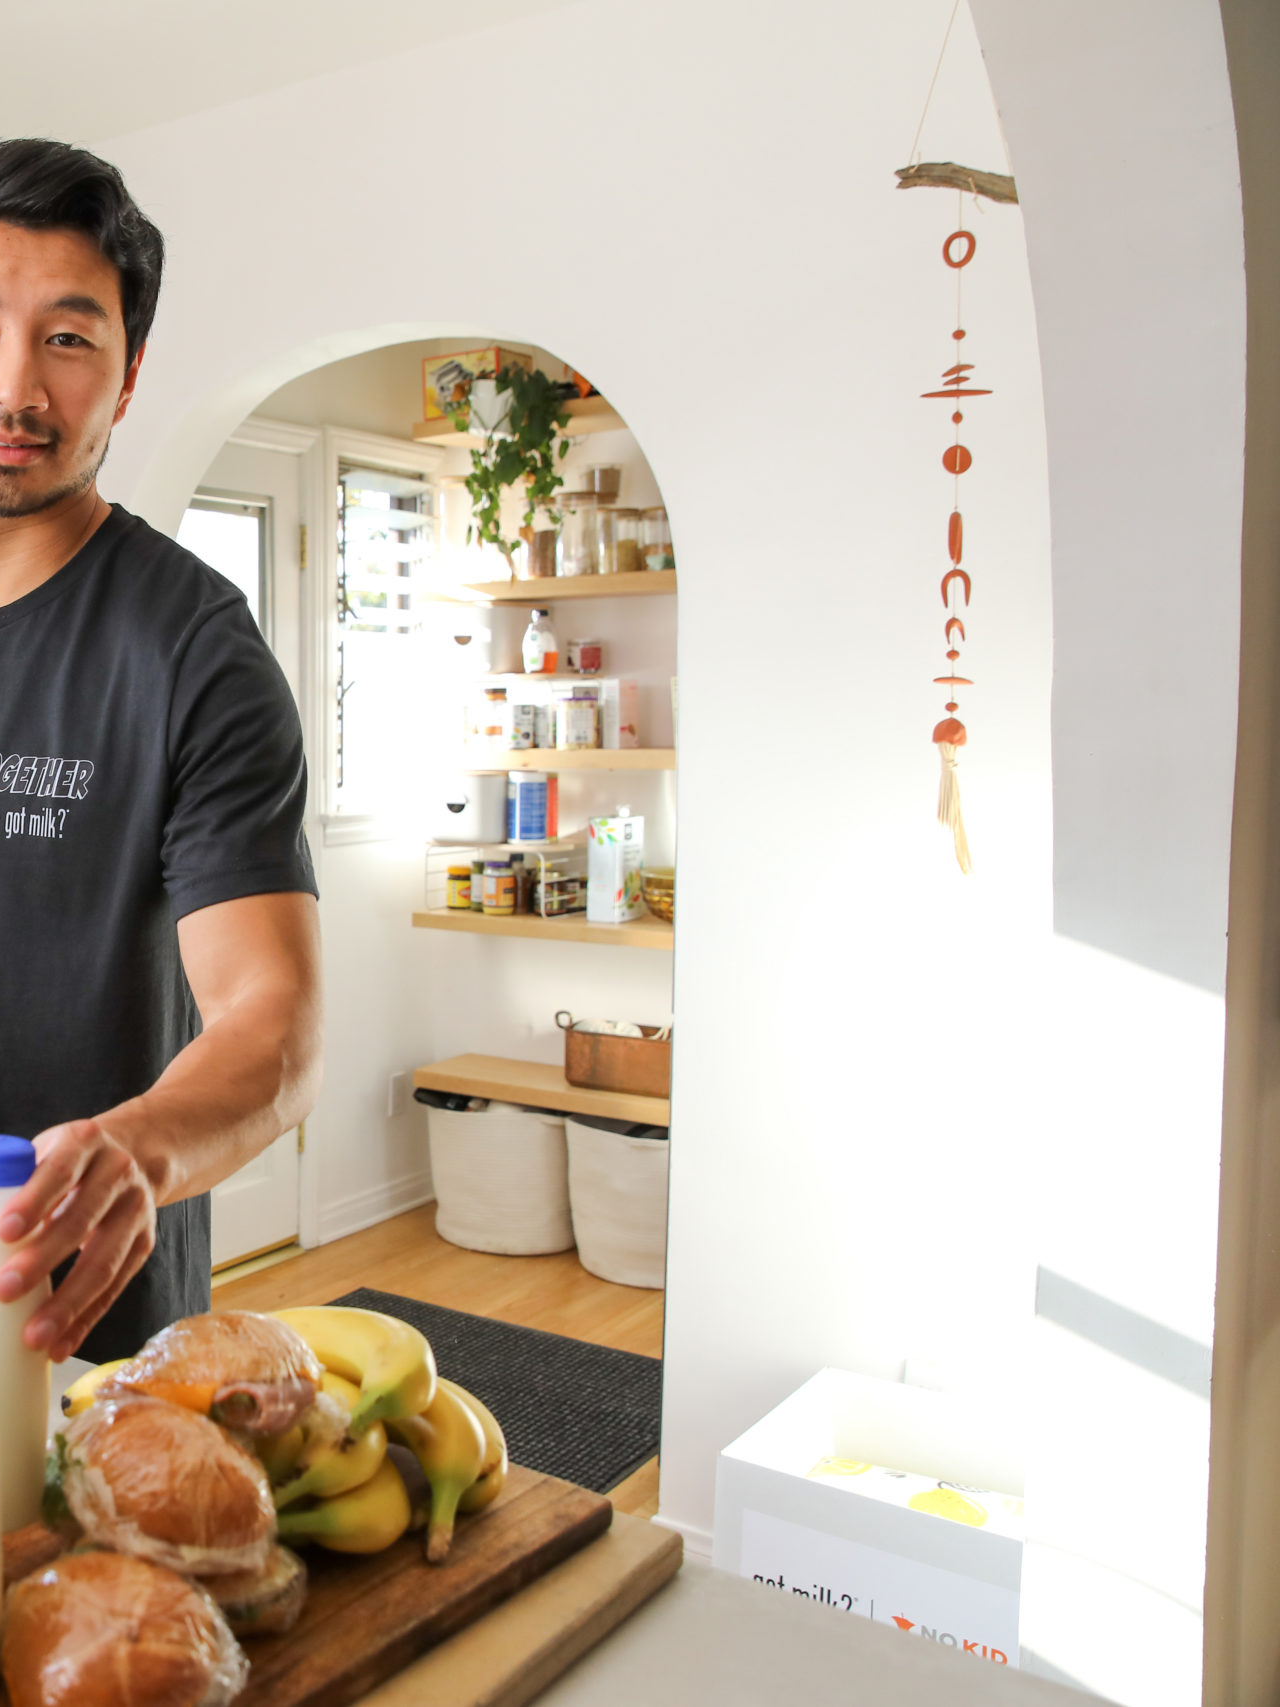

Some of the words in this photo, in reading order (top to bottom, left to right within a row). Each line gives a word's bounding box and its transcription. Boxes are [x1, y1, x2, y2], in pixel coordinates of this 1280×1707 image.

[5, 808, 26, 839] got
[29, 807, 66, 839] milk?
[963, 1639, 1008, 1665] KID
